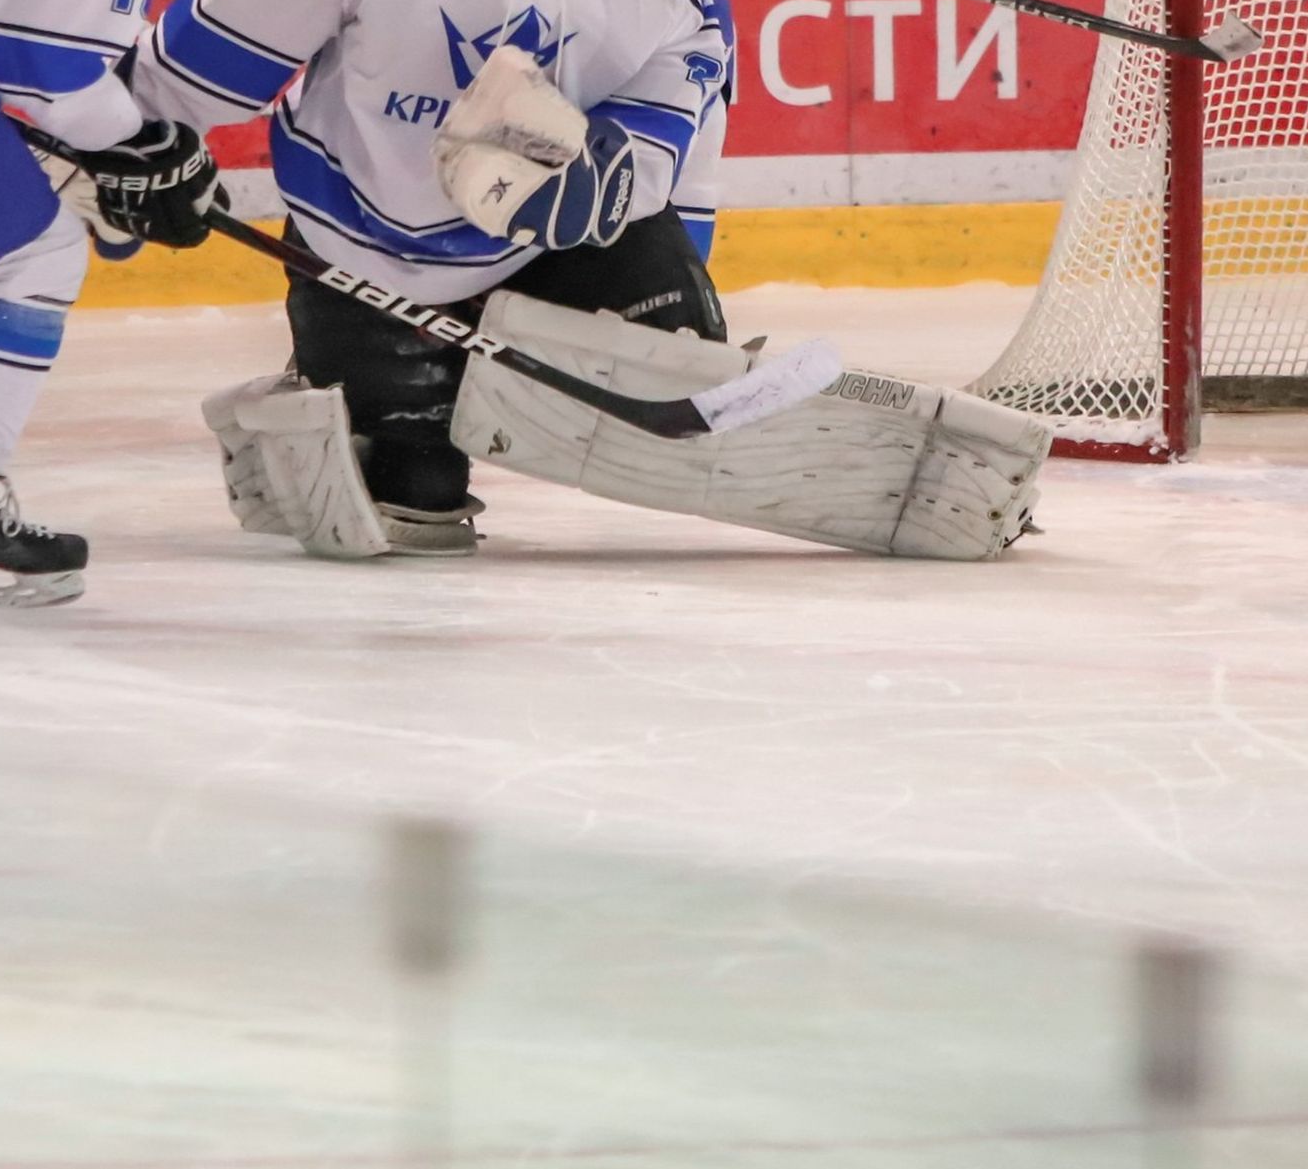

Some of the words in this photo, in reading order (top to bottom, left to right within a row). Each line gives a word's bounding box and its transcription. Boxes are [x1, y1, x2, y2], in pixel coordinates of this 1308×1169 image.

[95, 144, 212, 192] BAUER
[606, 167, 634, 224] Reebok
[317, 265, 507, 359] BAUER
[819, 372, 916, 410] UGHN
